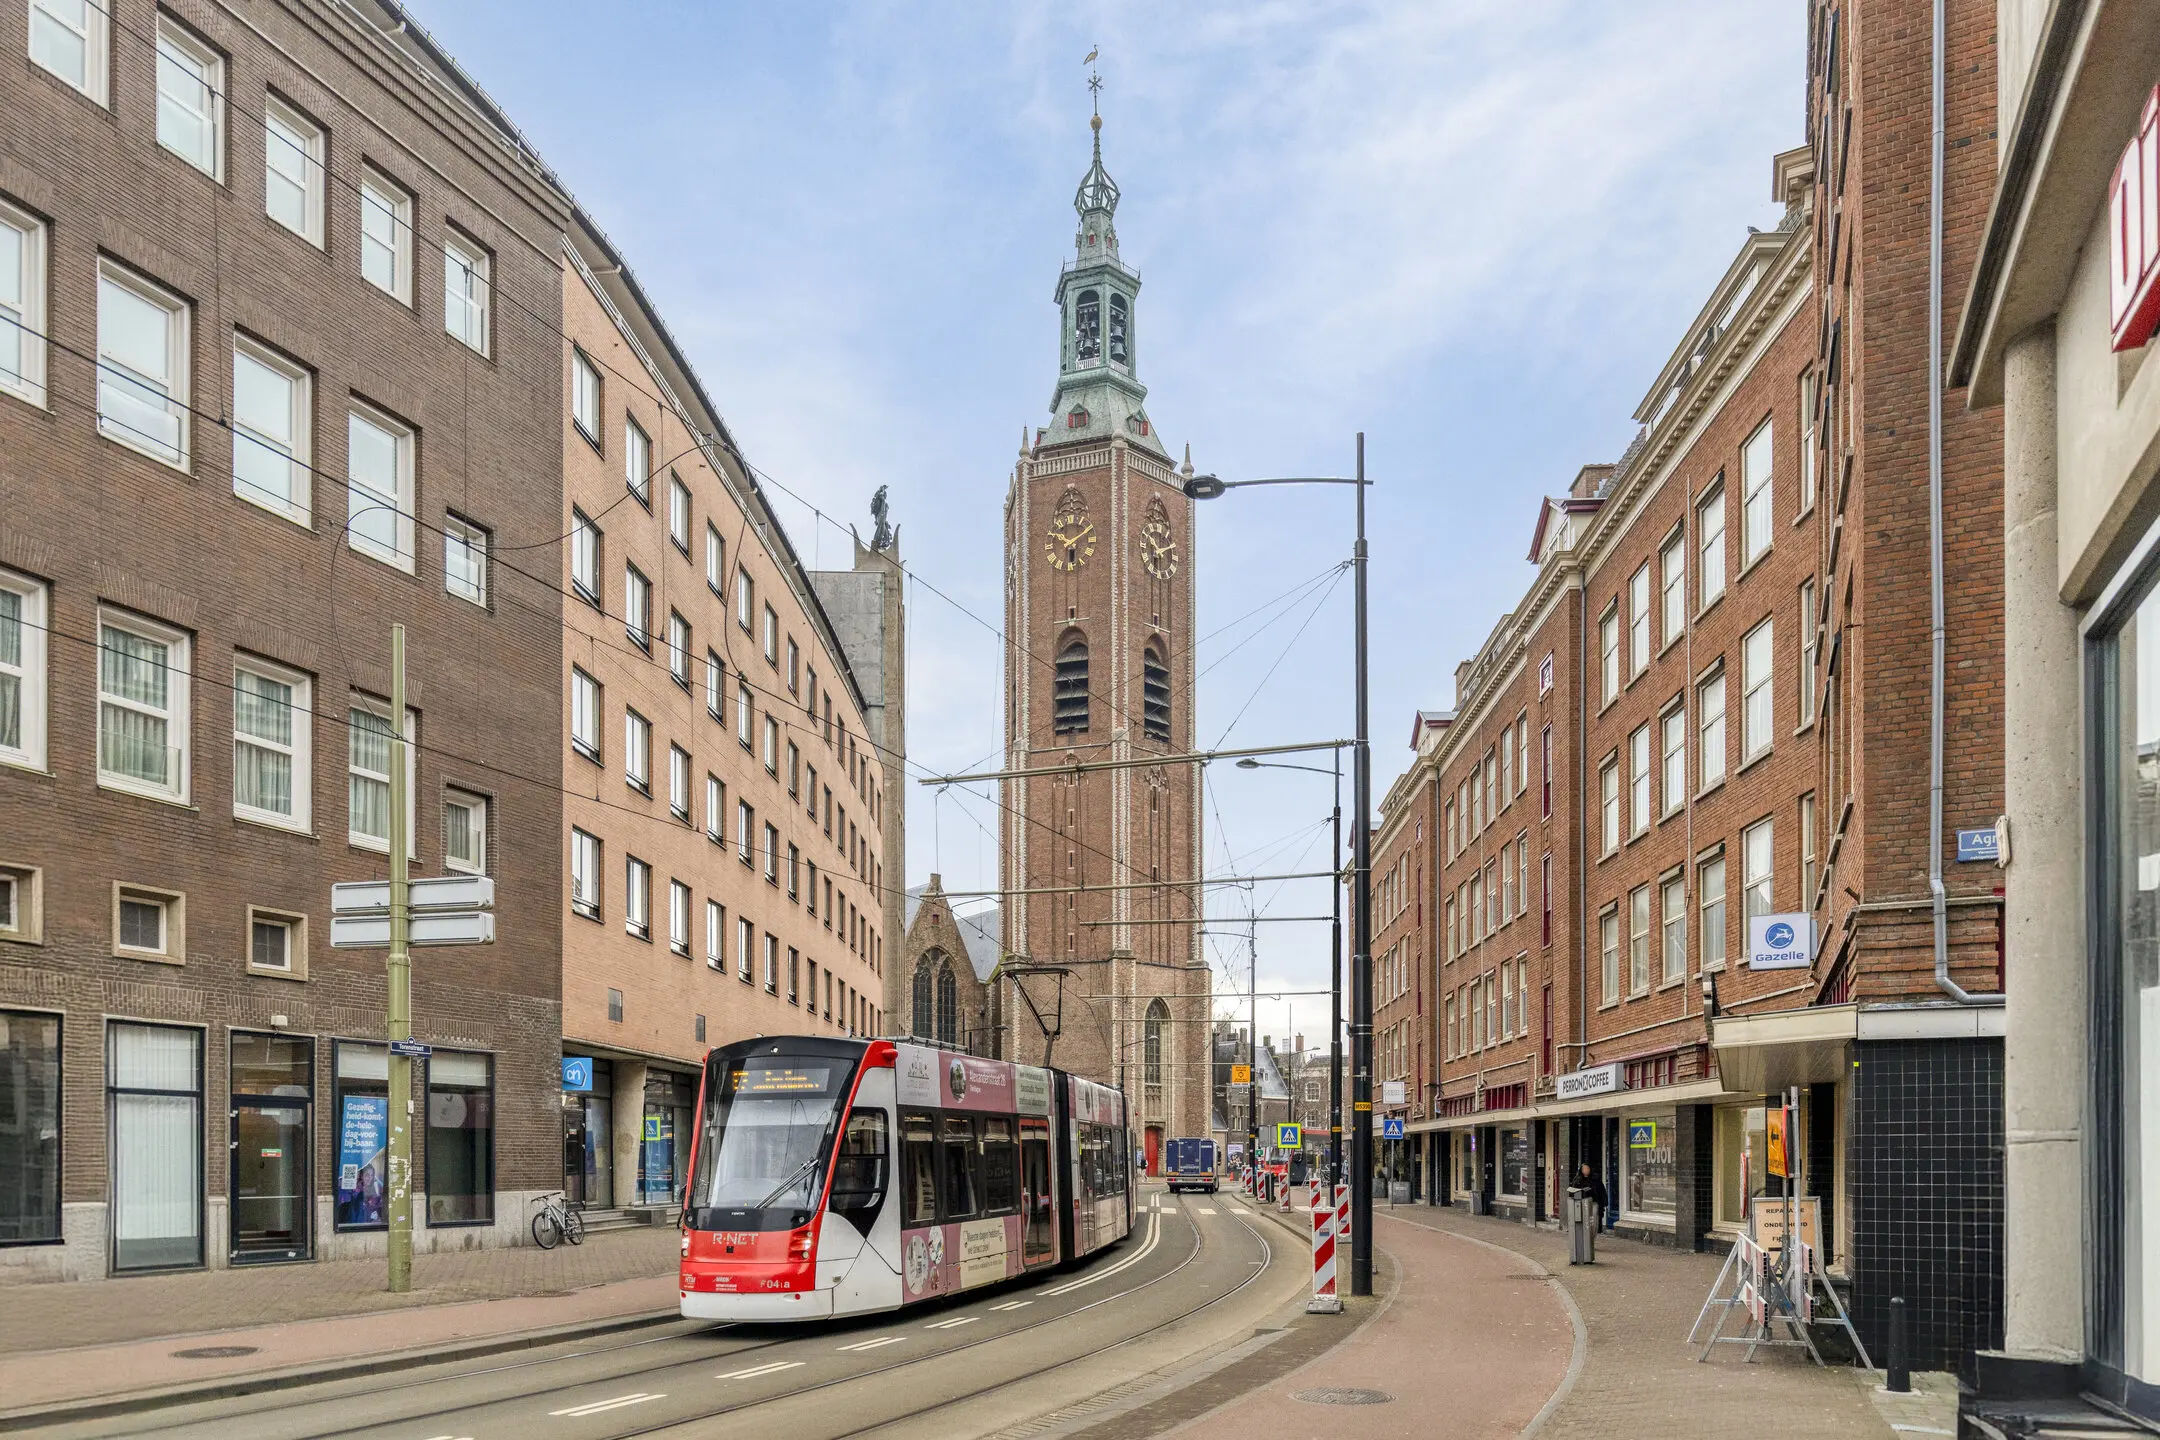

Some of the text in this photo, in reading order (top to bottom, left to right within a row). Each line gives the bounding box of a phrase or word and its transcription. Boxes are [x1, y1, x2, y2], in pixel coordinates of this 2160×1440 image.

[1755, 951, 1804, 962] Gazelle
[1562, 1077, 1583, 1093] PERRON
[1588, 1071, 1609, 1089] COFFEE
[346, 1103, 376, 1113] Gezellig-
[346, 1111, 384, 1121] heid-komt-
